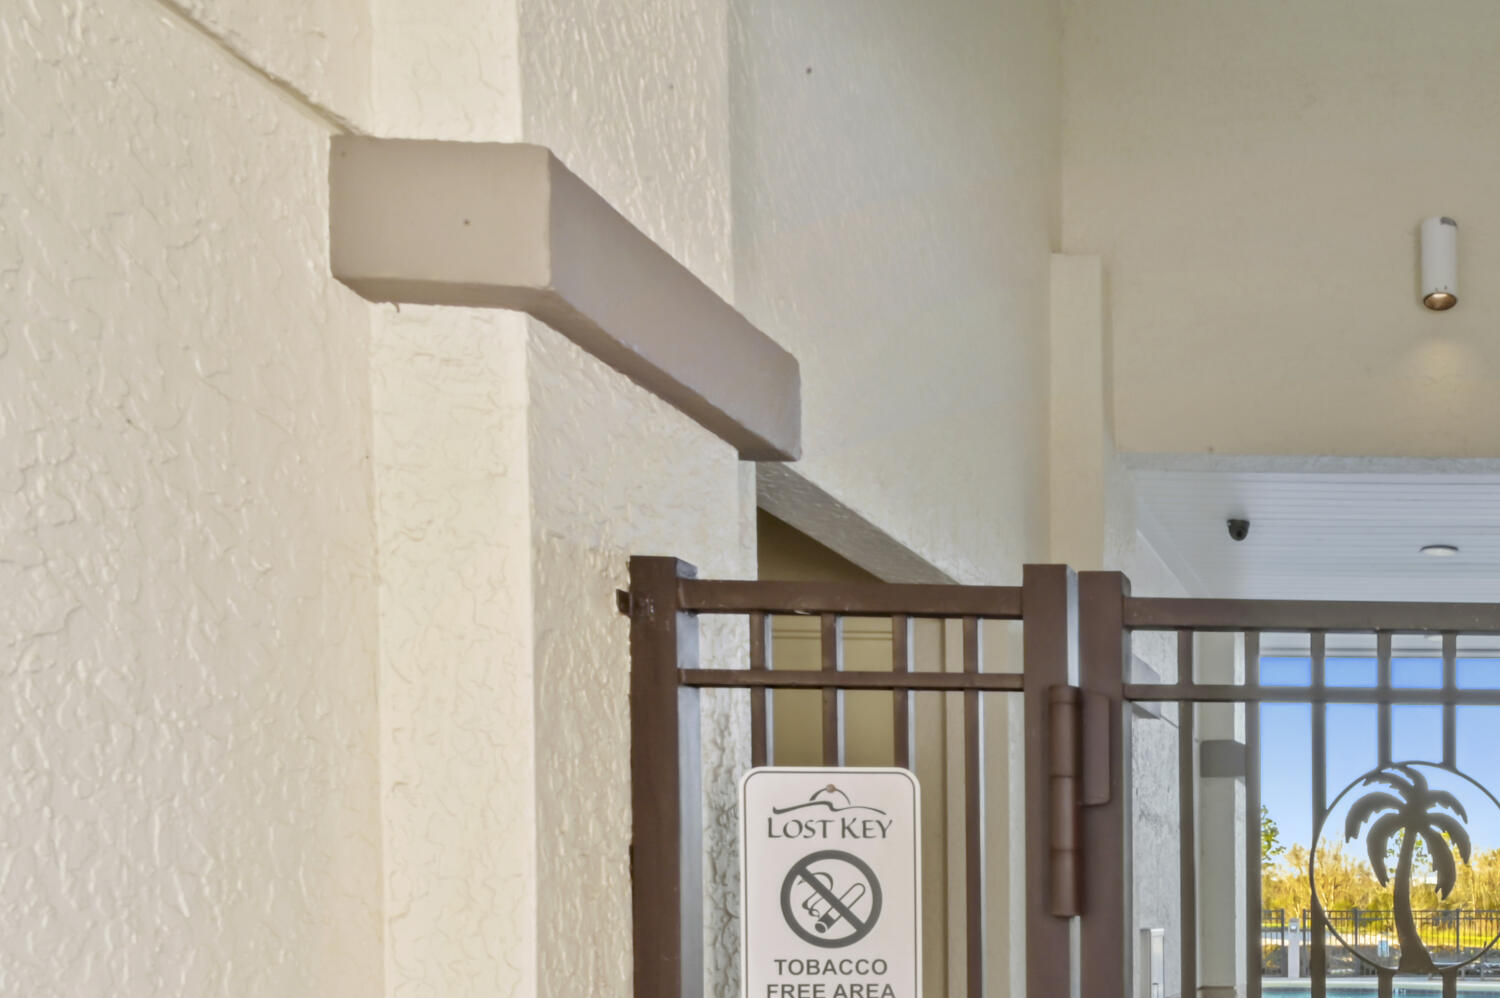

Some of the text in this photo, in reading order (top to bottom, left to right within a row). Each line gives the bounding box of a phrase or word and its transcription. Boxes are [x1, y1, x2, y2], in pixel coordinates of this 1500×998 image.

[767, 817, 893, 839] LOST KEY
[774, 959, 888, 976] TOBACCO
